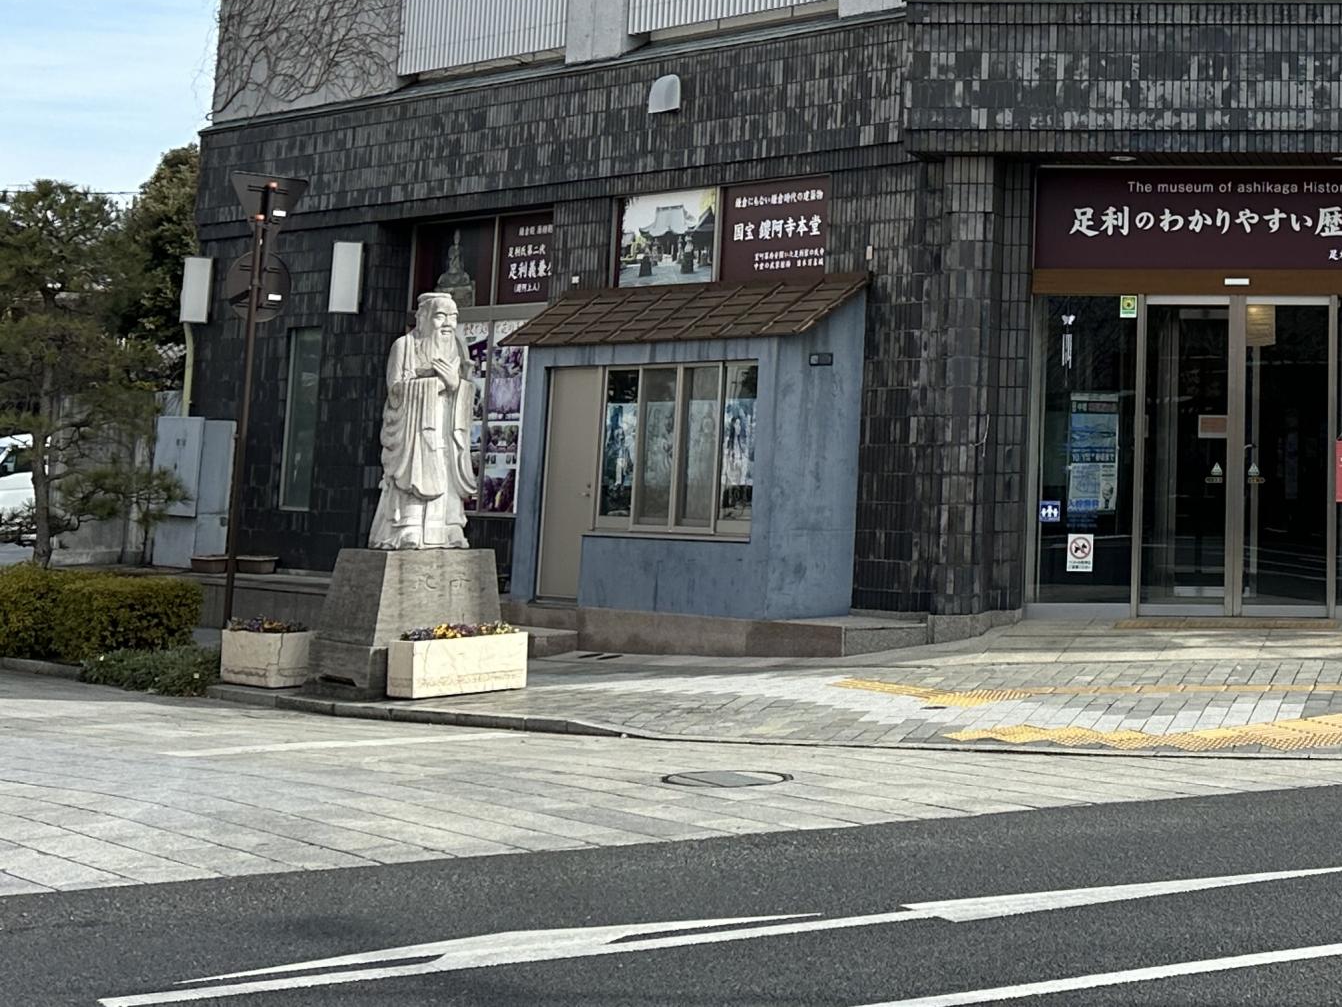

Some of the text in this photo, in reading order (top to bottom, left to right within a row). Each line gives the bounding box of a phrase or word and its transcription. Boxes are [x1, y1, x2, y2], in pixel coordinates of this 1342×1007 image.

[1127, 181, 1152, 193] The
[1157, 182, 1214, 194] museum
[1218, 181, 1232, 193] of
[1236, 181, 1298, 194] ashikaga
[733, 214, 822, 241] 国宝 鑁阿寺本堂
